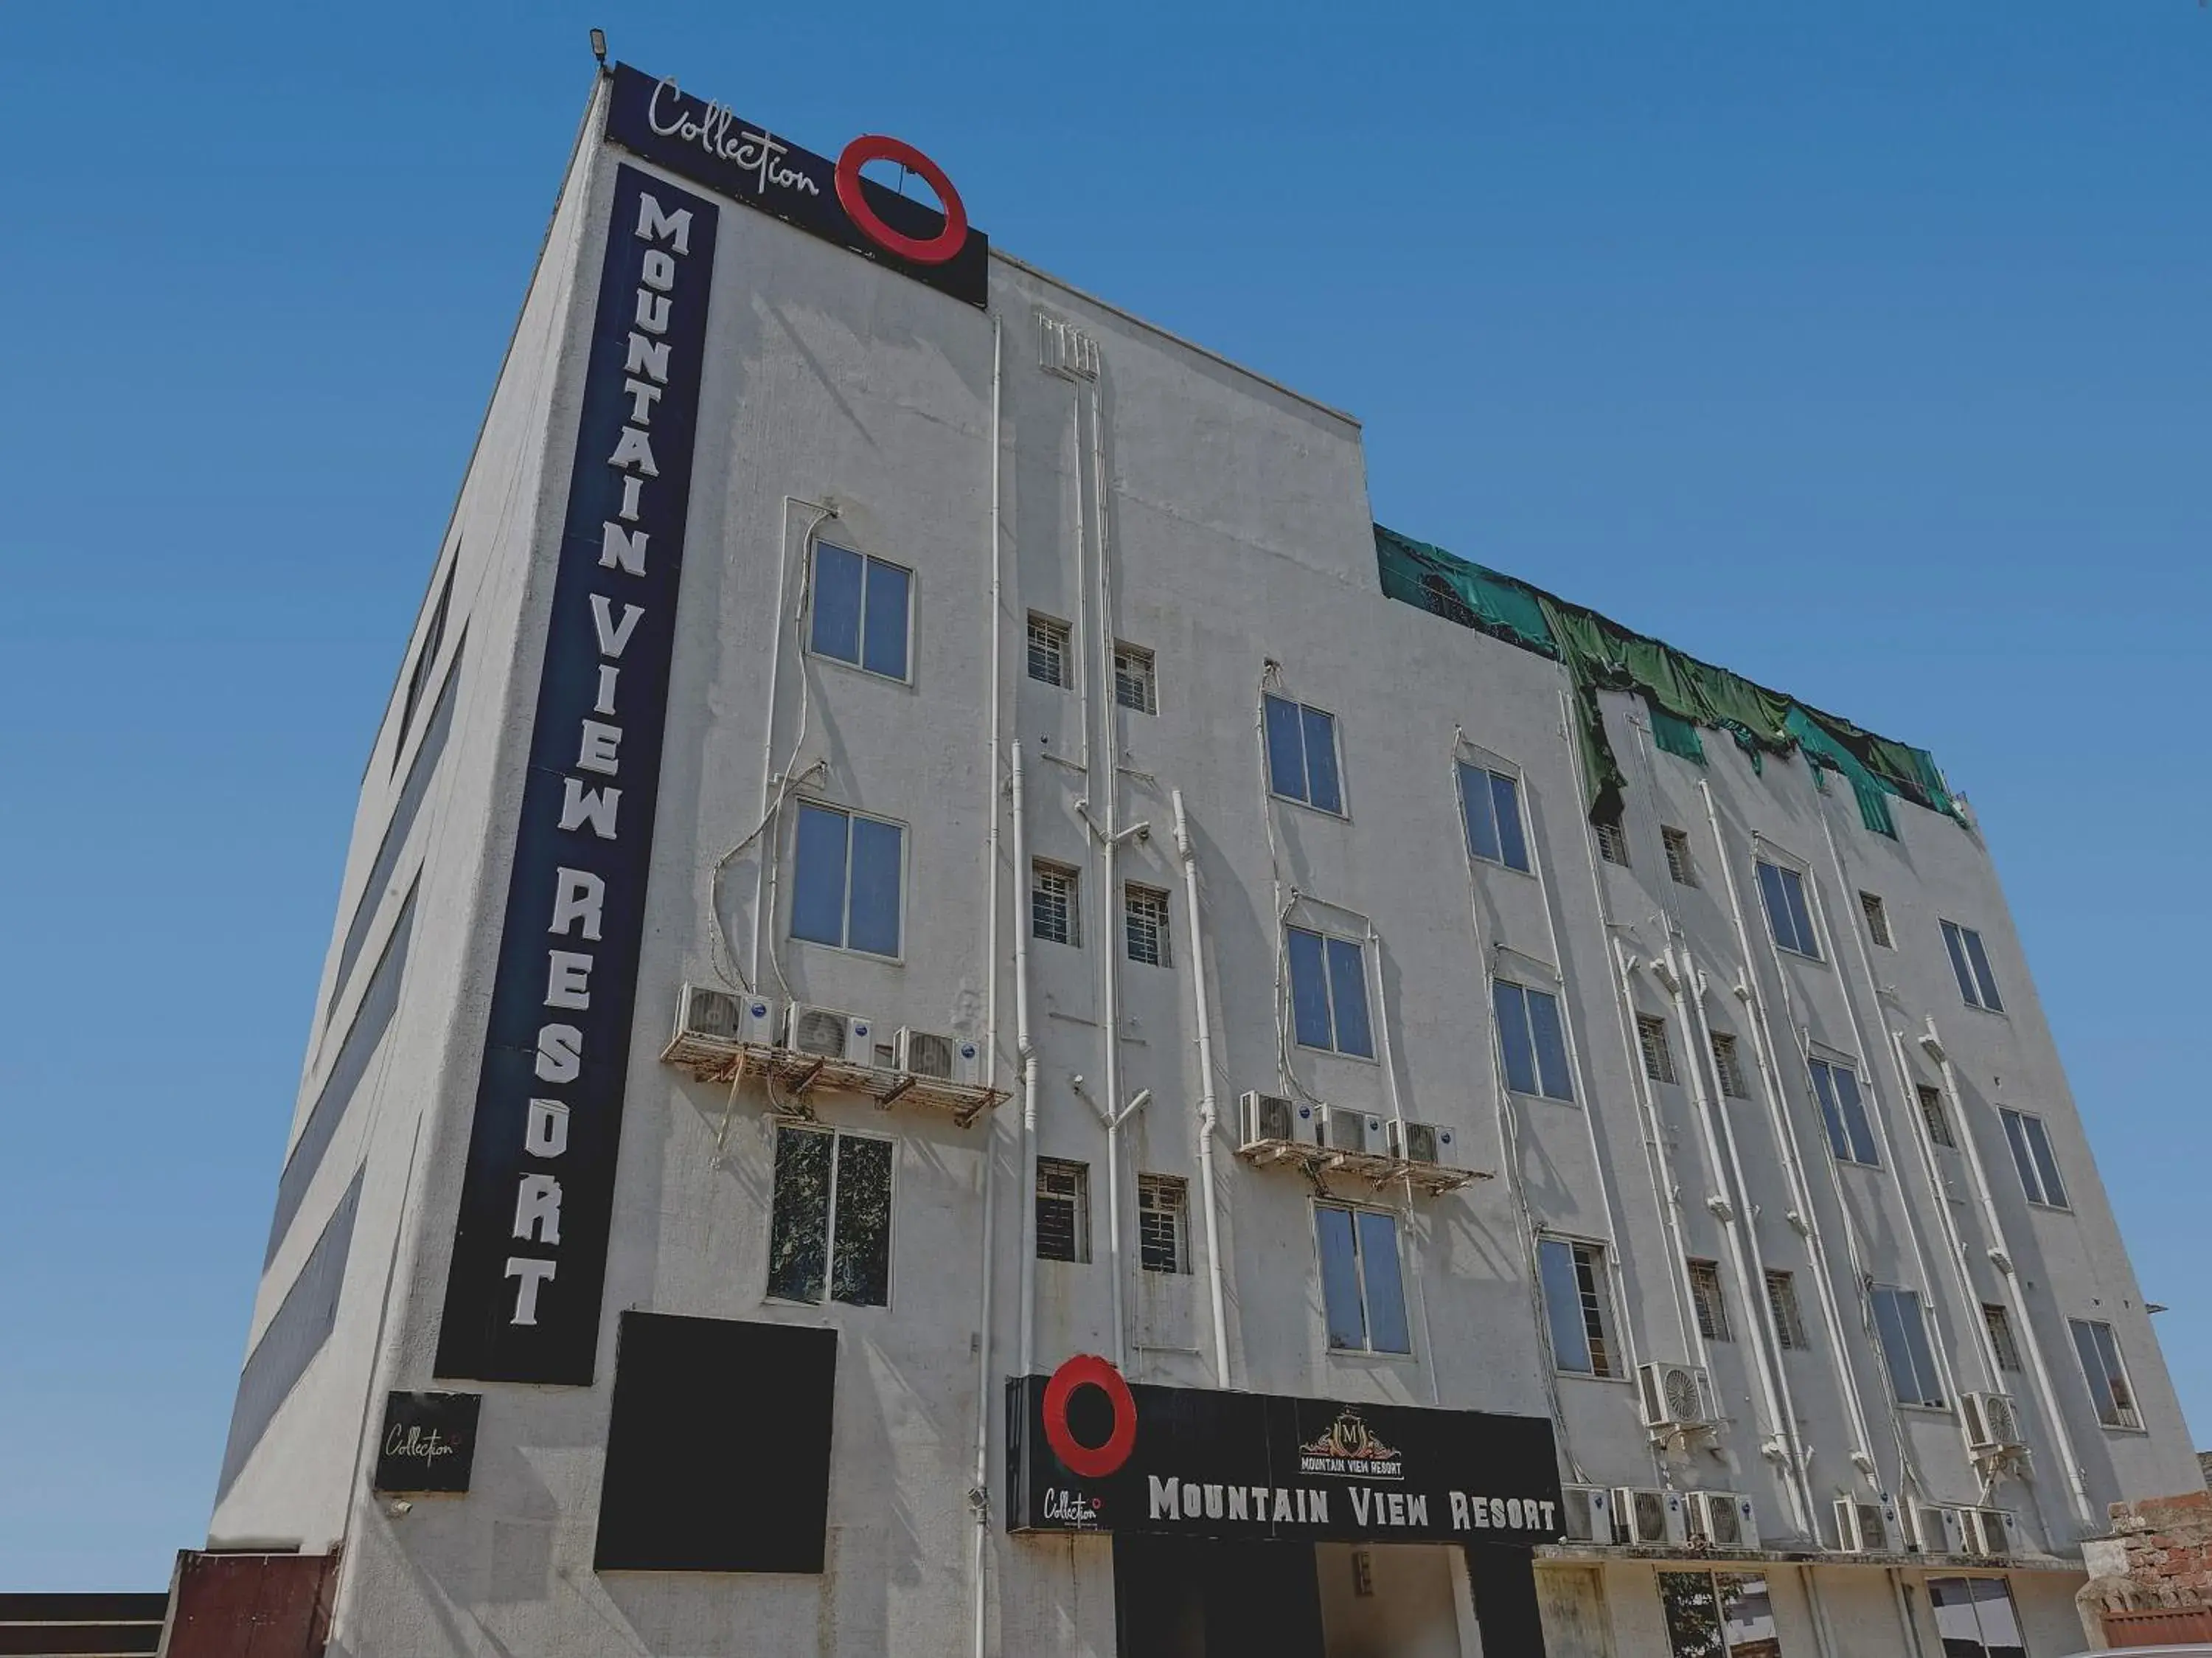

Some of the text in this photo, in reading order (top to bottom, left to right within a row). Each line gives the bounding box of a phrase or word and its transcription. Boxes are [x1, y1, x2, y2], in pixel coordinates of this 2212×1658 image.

[648, 74, 819, 195] Collection
[504, 191, 693, 1327] MOUNTAIN VIEW RESORT
[386, 1423, 453, 1468] Collection
[1342, 1424, 1357, 1443] M
[1301, 1457, 1402, 1474] MOUNTAIN VIEW RESORT
[1043, 1488, 1096, 1529] Collection
[1148, 1474, 1556, 1531] MOUNTAIN VIEW RESORT
